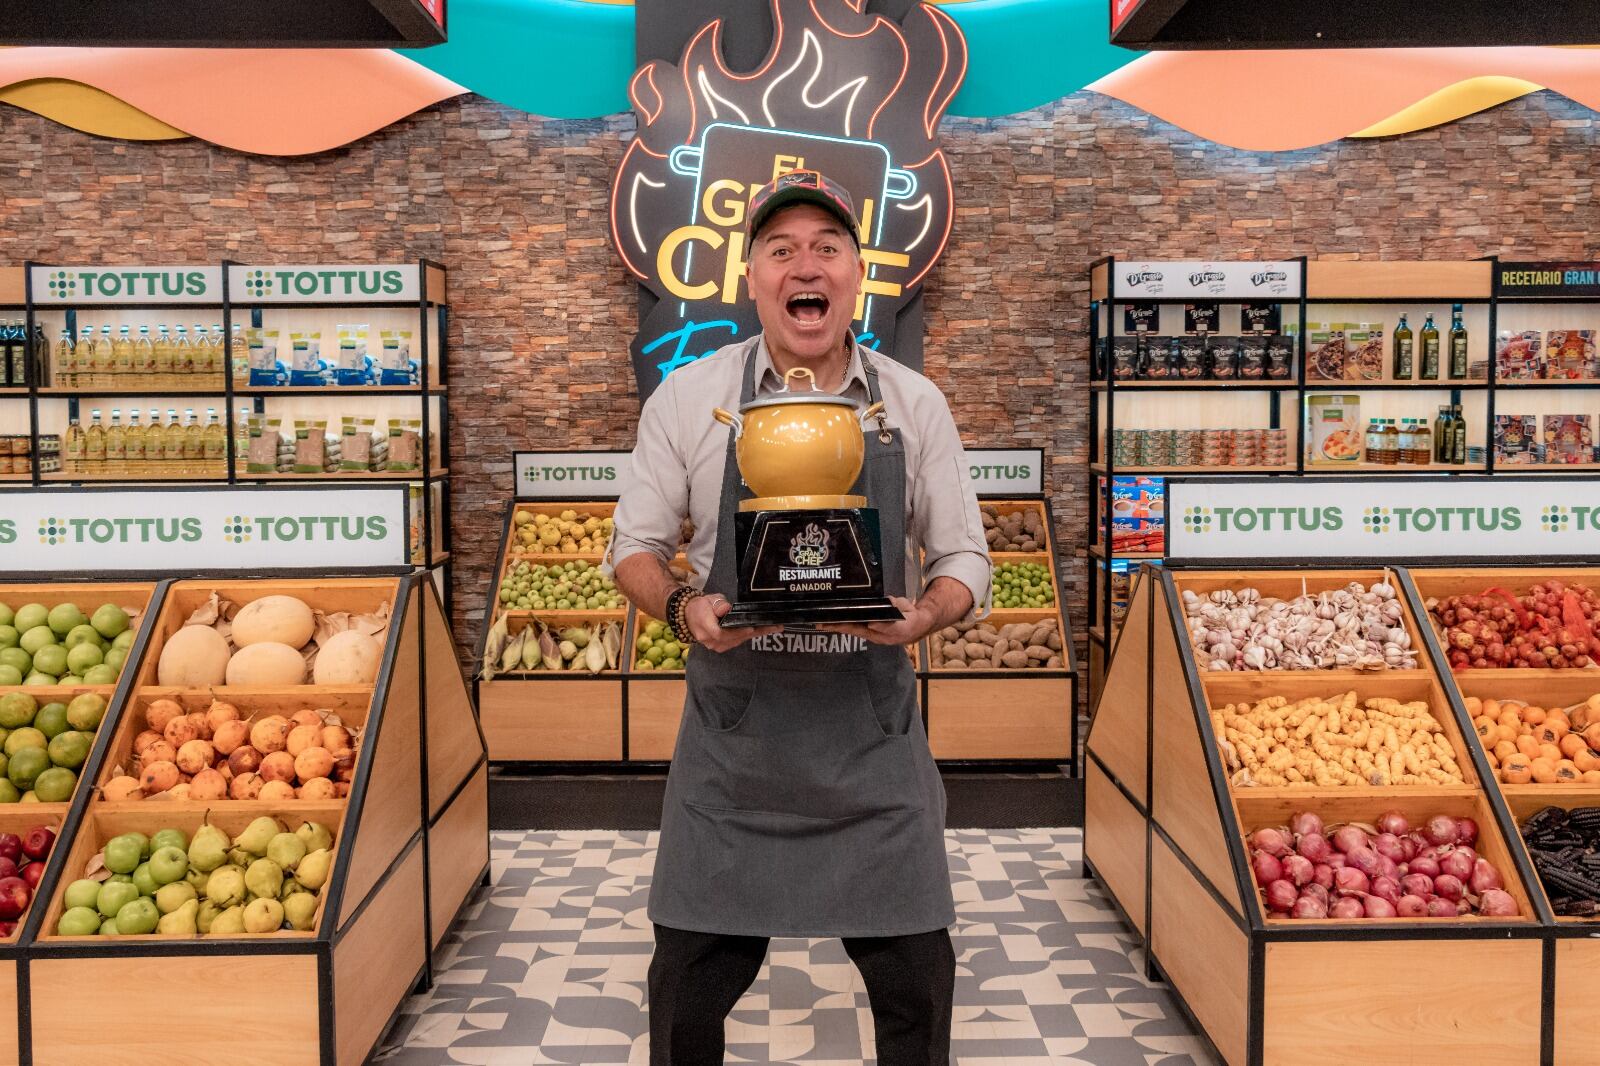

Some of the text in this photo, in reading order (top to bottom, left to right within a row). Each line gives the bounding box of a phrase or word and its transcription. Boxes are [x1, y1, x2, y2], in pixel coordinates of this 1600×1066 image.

[78, 271, 207, 297] TOTTUS
[275, 269, 404, 296] TOTTUS
[1502, 270, 1595, 286] RECETARIO GRAN
[541, 466, 617, 481] TOTTUS
[969, 465, 1031, 480] OTTUS
[1213, 506, 1344, 532] TOTTUS
[1392, 506, 1522, 532] TOTTUS
[70, 517, 203, 543] TOTTUS
[255, 515, 388, 541] TOTTUS
[799, 549, 820, 557] GRAN
[795, 556, 823, 566] CHEF
[779, 567, 842, 582] RESTAURANTE
[789, 582, 833, 592] GANADOR
